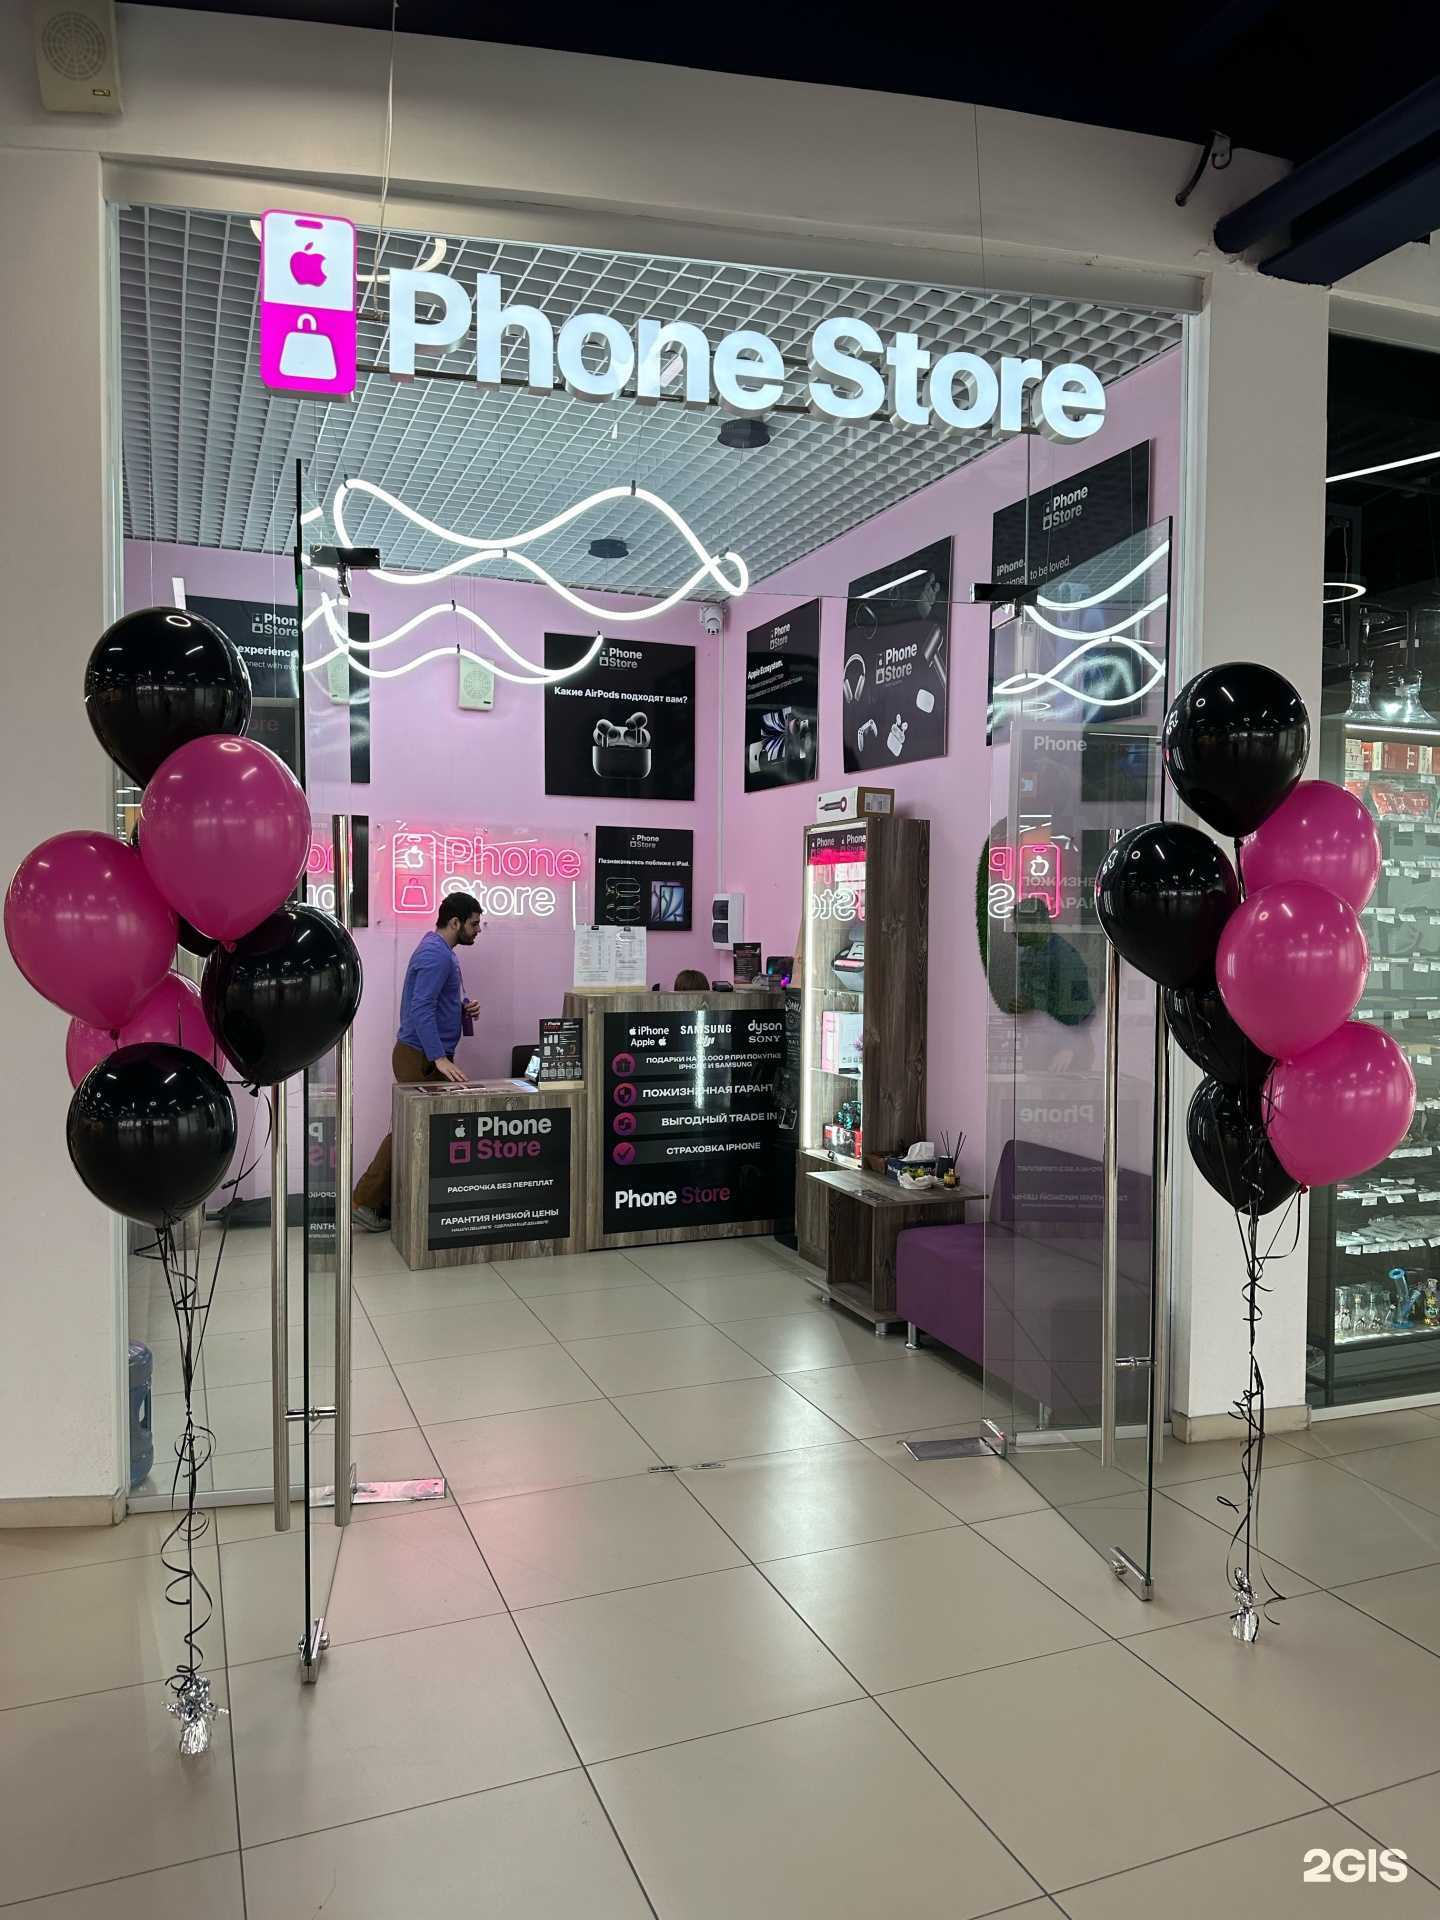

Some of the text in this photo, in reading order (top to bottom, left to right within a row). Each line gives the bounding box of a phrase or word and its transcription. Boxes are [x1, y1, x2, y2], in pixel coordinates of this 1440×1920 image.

[389, 267, 1107, 444] Phone Store
[1053, 486, 1088, 510] Phone
[1052, 504, 1082, 526] Store
[1030, 570, 1038, 580] to
[1039, 565, 1047, 577] be
[264, 613, 298, 626] Phon
[264, 624, 298, 637] Store
[774, 624, 790, 637] Phone
[238, 645, 299, 658] experience
[609, 647, 642, 659] Phone
[886, 643, 918, 666] Phone
[609, 658, 638, 669] Store
[885, 662, 912, 682] Store
[554, 686, 688, 704] Какие AirPods подходят вам?
[636, 834, 660, 842] Phone
[816, 837, 835, 848] Phone
[846, 834, 866, 844] Phone
[443, 836, 582, 879] Phone
[638, 1025, 670, 1036] iPhone
[748, 1020, 783, 1034] dyson
[630, 1037, 656, 1048] Apple
[748, 1035, 782, 1044] SONY
[646, 1056, 686, 1064] ПОДАРКИ
[714, 1061, 752, 1069] SAMSUNG
[642, 1086, 732, 1098] ПОЖИЗНННАЯ
[662, 1112, 778, 1126] ВЫГОДНЫЙ TRADE IN
[478, 1116, 552, 1137] Phone
[478, 1138, 541, 1160] Store
[666, 1142, 761, 1155] СТРАХОВКА IPHONE
[448, 1179, 554, 1193] РАССРОЧКА БЕЗ ПЕРЕПЛАТ
[615, 1186, 731, 1210] Phone Store
[440, 1214, 490, 1226] ГАРАНТИЯ
[492, 1210, 531, 1221] НИЗКОЙ
[532, 1208, 560, 1218] ЦЕНЫ
